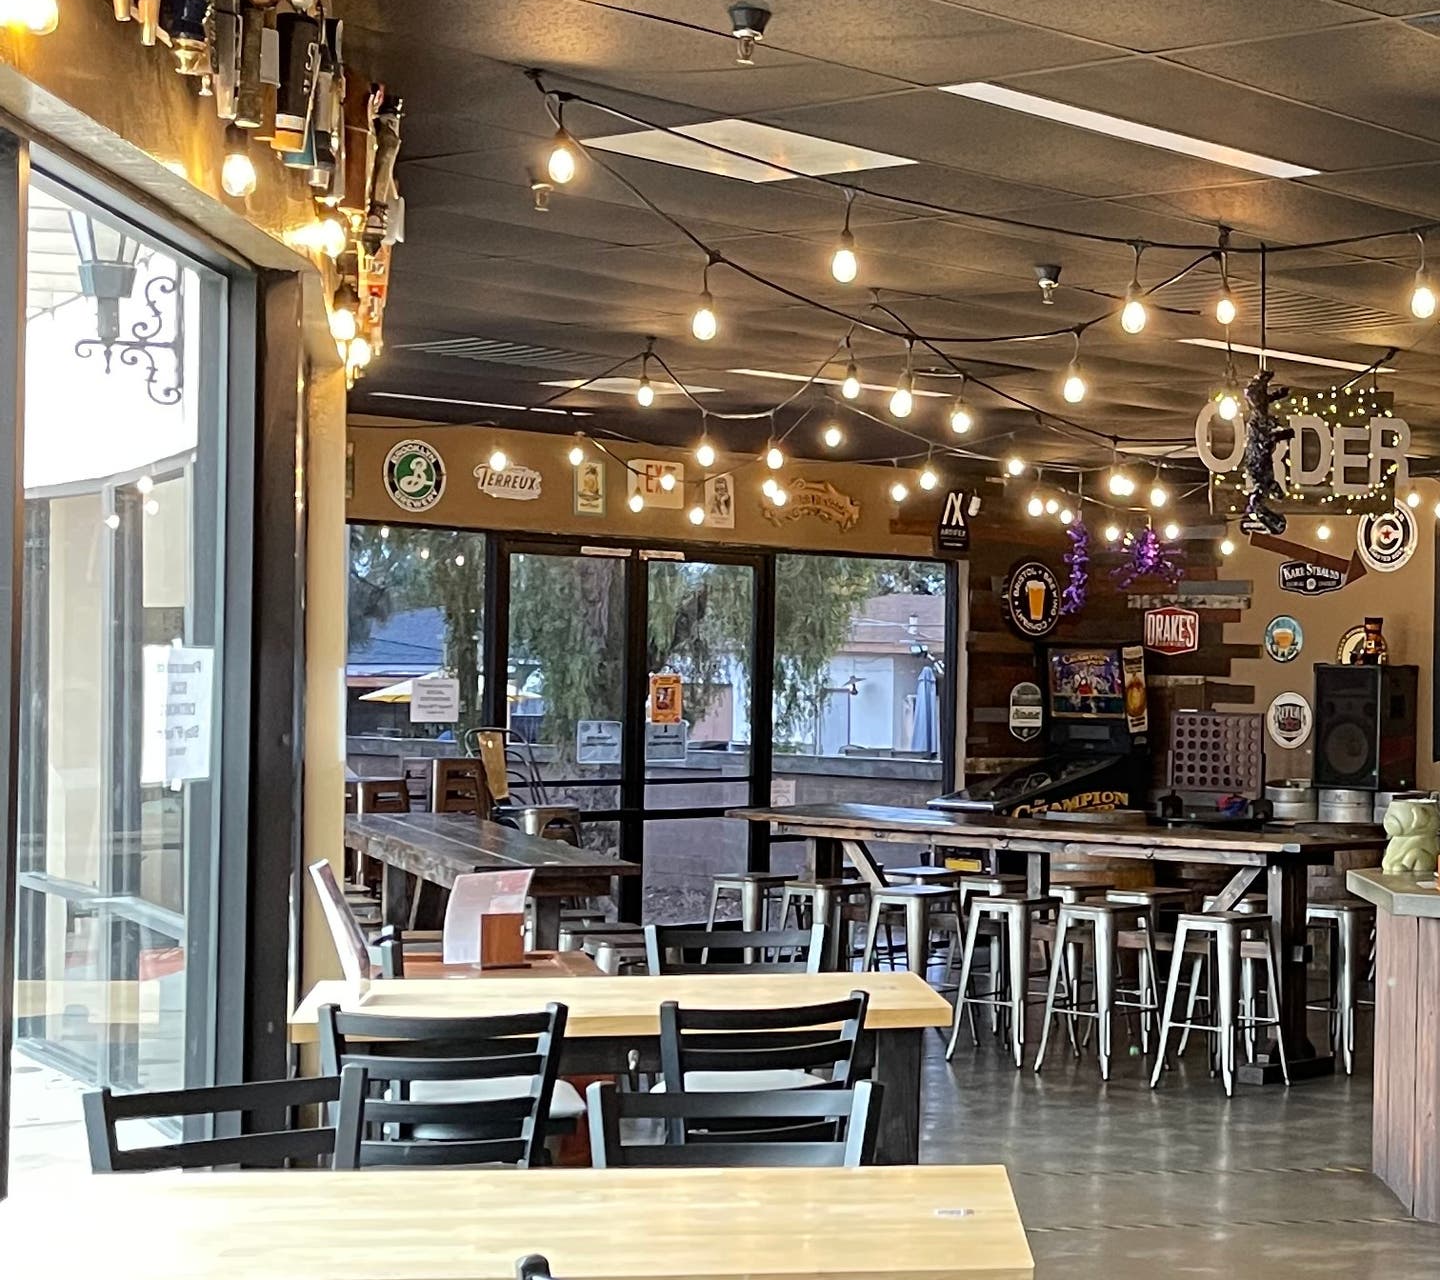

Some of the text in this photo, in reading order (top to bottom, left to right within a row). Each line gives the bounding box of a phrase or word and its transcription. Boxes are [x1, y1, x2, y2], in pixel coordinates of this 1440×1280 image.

[390, 444, 438, 464] BROOKLYN
[479, 469, 537, 490] TERREUX
[646, 463, 676, 494] EX
[394, 488, 438, 508] BREWERY
[1012, 567, 1037, 597] BRISTOL
[1147, 613, 1195, 648] DRAKE'S
